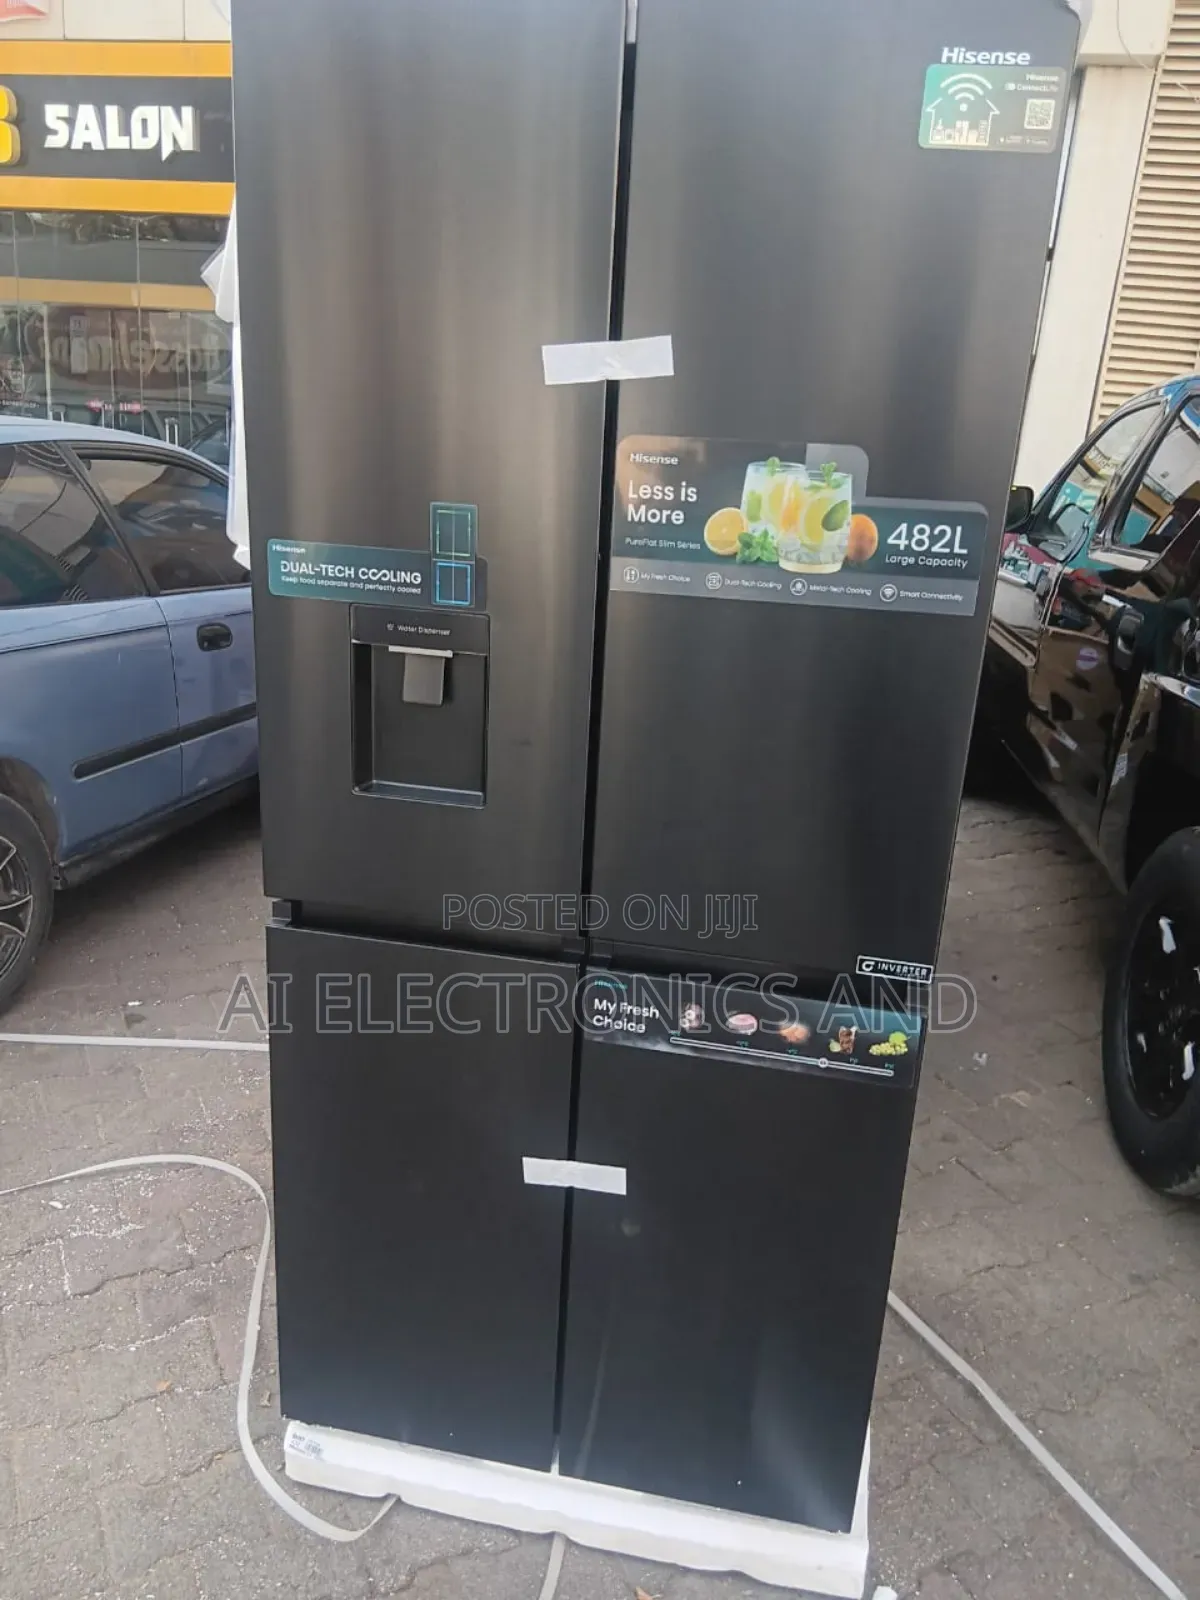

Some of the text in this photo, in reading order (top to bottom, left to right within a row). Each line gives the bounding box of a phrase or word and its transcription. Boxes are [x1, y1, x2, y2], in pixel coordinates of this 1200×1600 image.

[941, 47, 1031, 66] Hisense
[43, 103, 196, 162] SALON
[629, 453, 679, 466] Hisense
[627, 480, 698, 502] Less is
[627, 504, 685, 525] More
[677, 540, 701, 550] Series
[886, 522, 968, 555] 482L
[885, 553, 968, 569] Large Capacity
[280, 560, 422, 584] DUAL-TECH COOLING
[877, 962, 928, 977] INVERTER
[593, 998, 660, 1019] My Fresh
[592, 1014, 647, 1034] Choice
